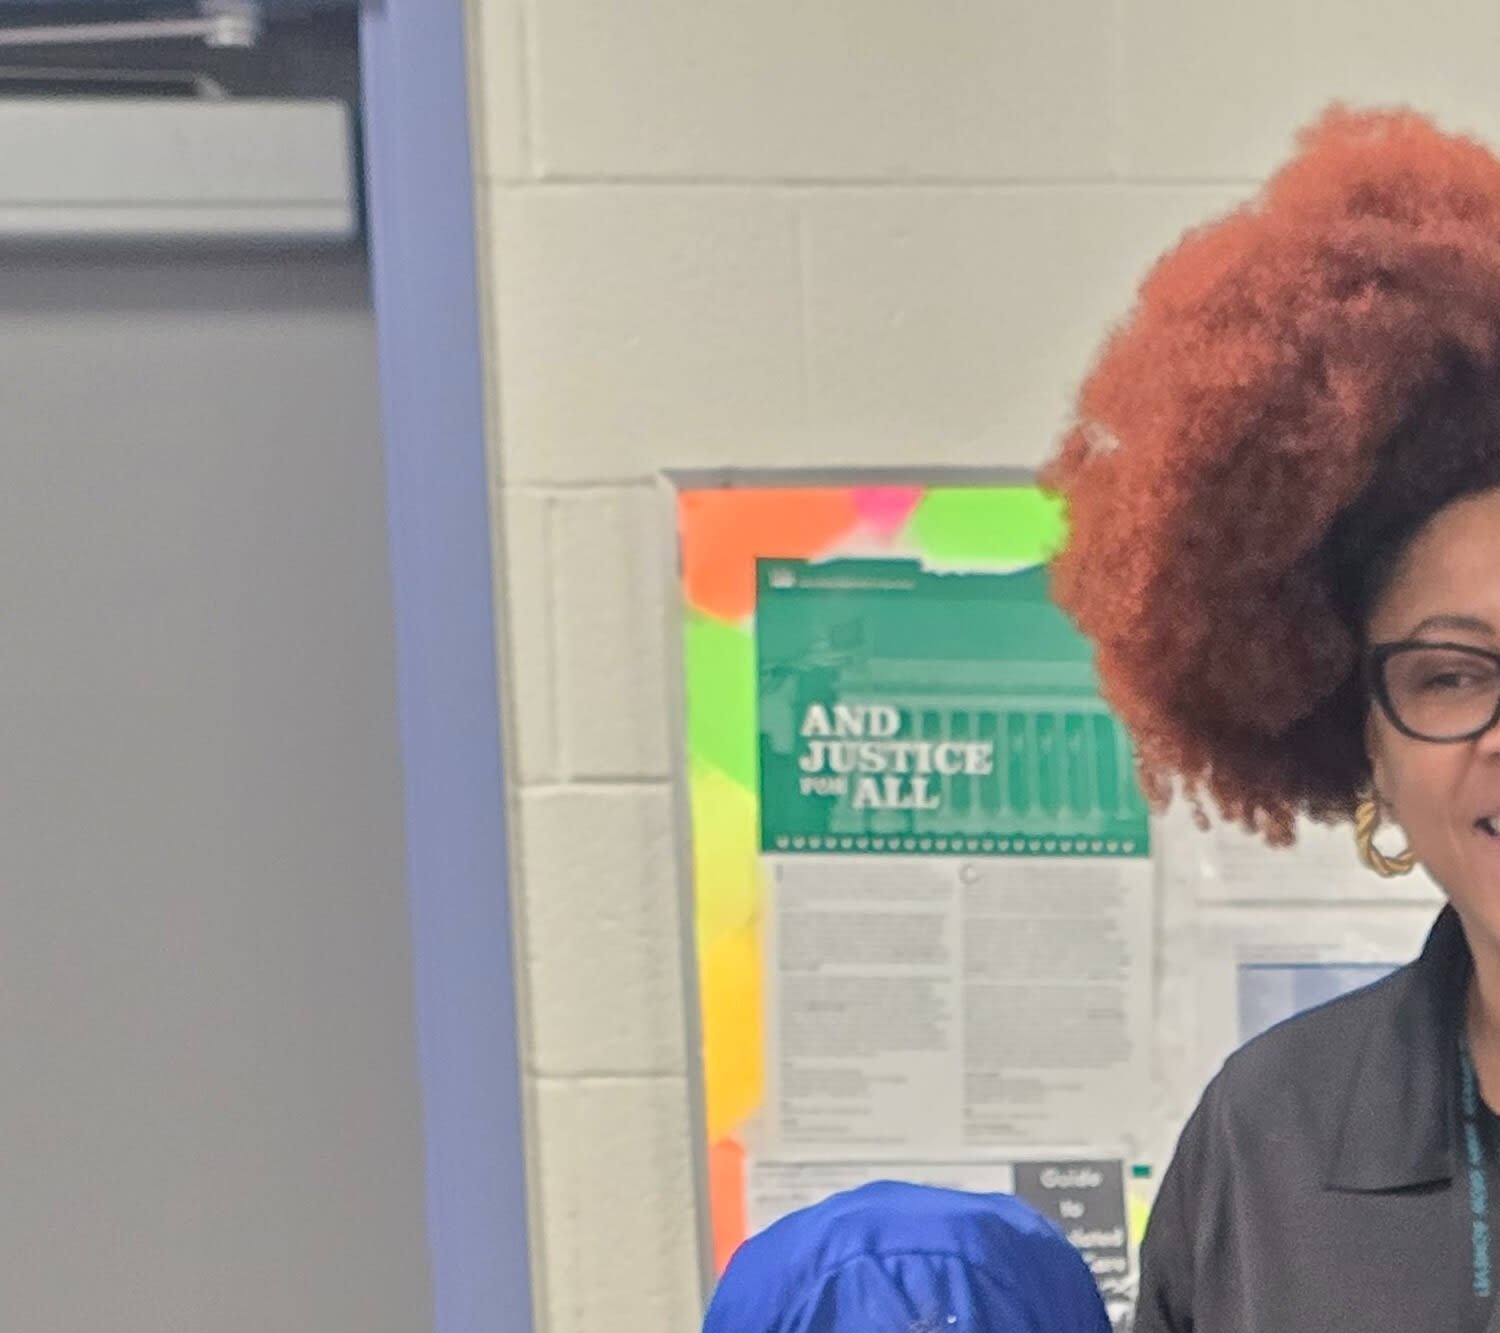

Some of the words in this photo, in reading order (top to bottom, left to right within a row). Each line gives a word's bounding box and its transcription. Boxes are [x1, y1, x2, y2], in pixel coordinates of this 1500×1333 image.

[800, 704, 900, 737] AND
[798, 740, 994, 775] JUSTICE
[852, 776, 940, 809] ALL
